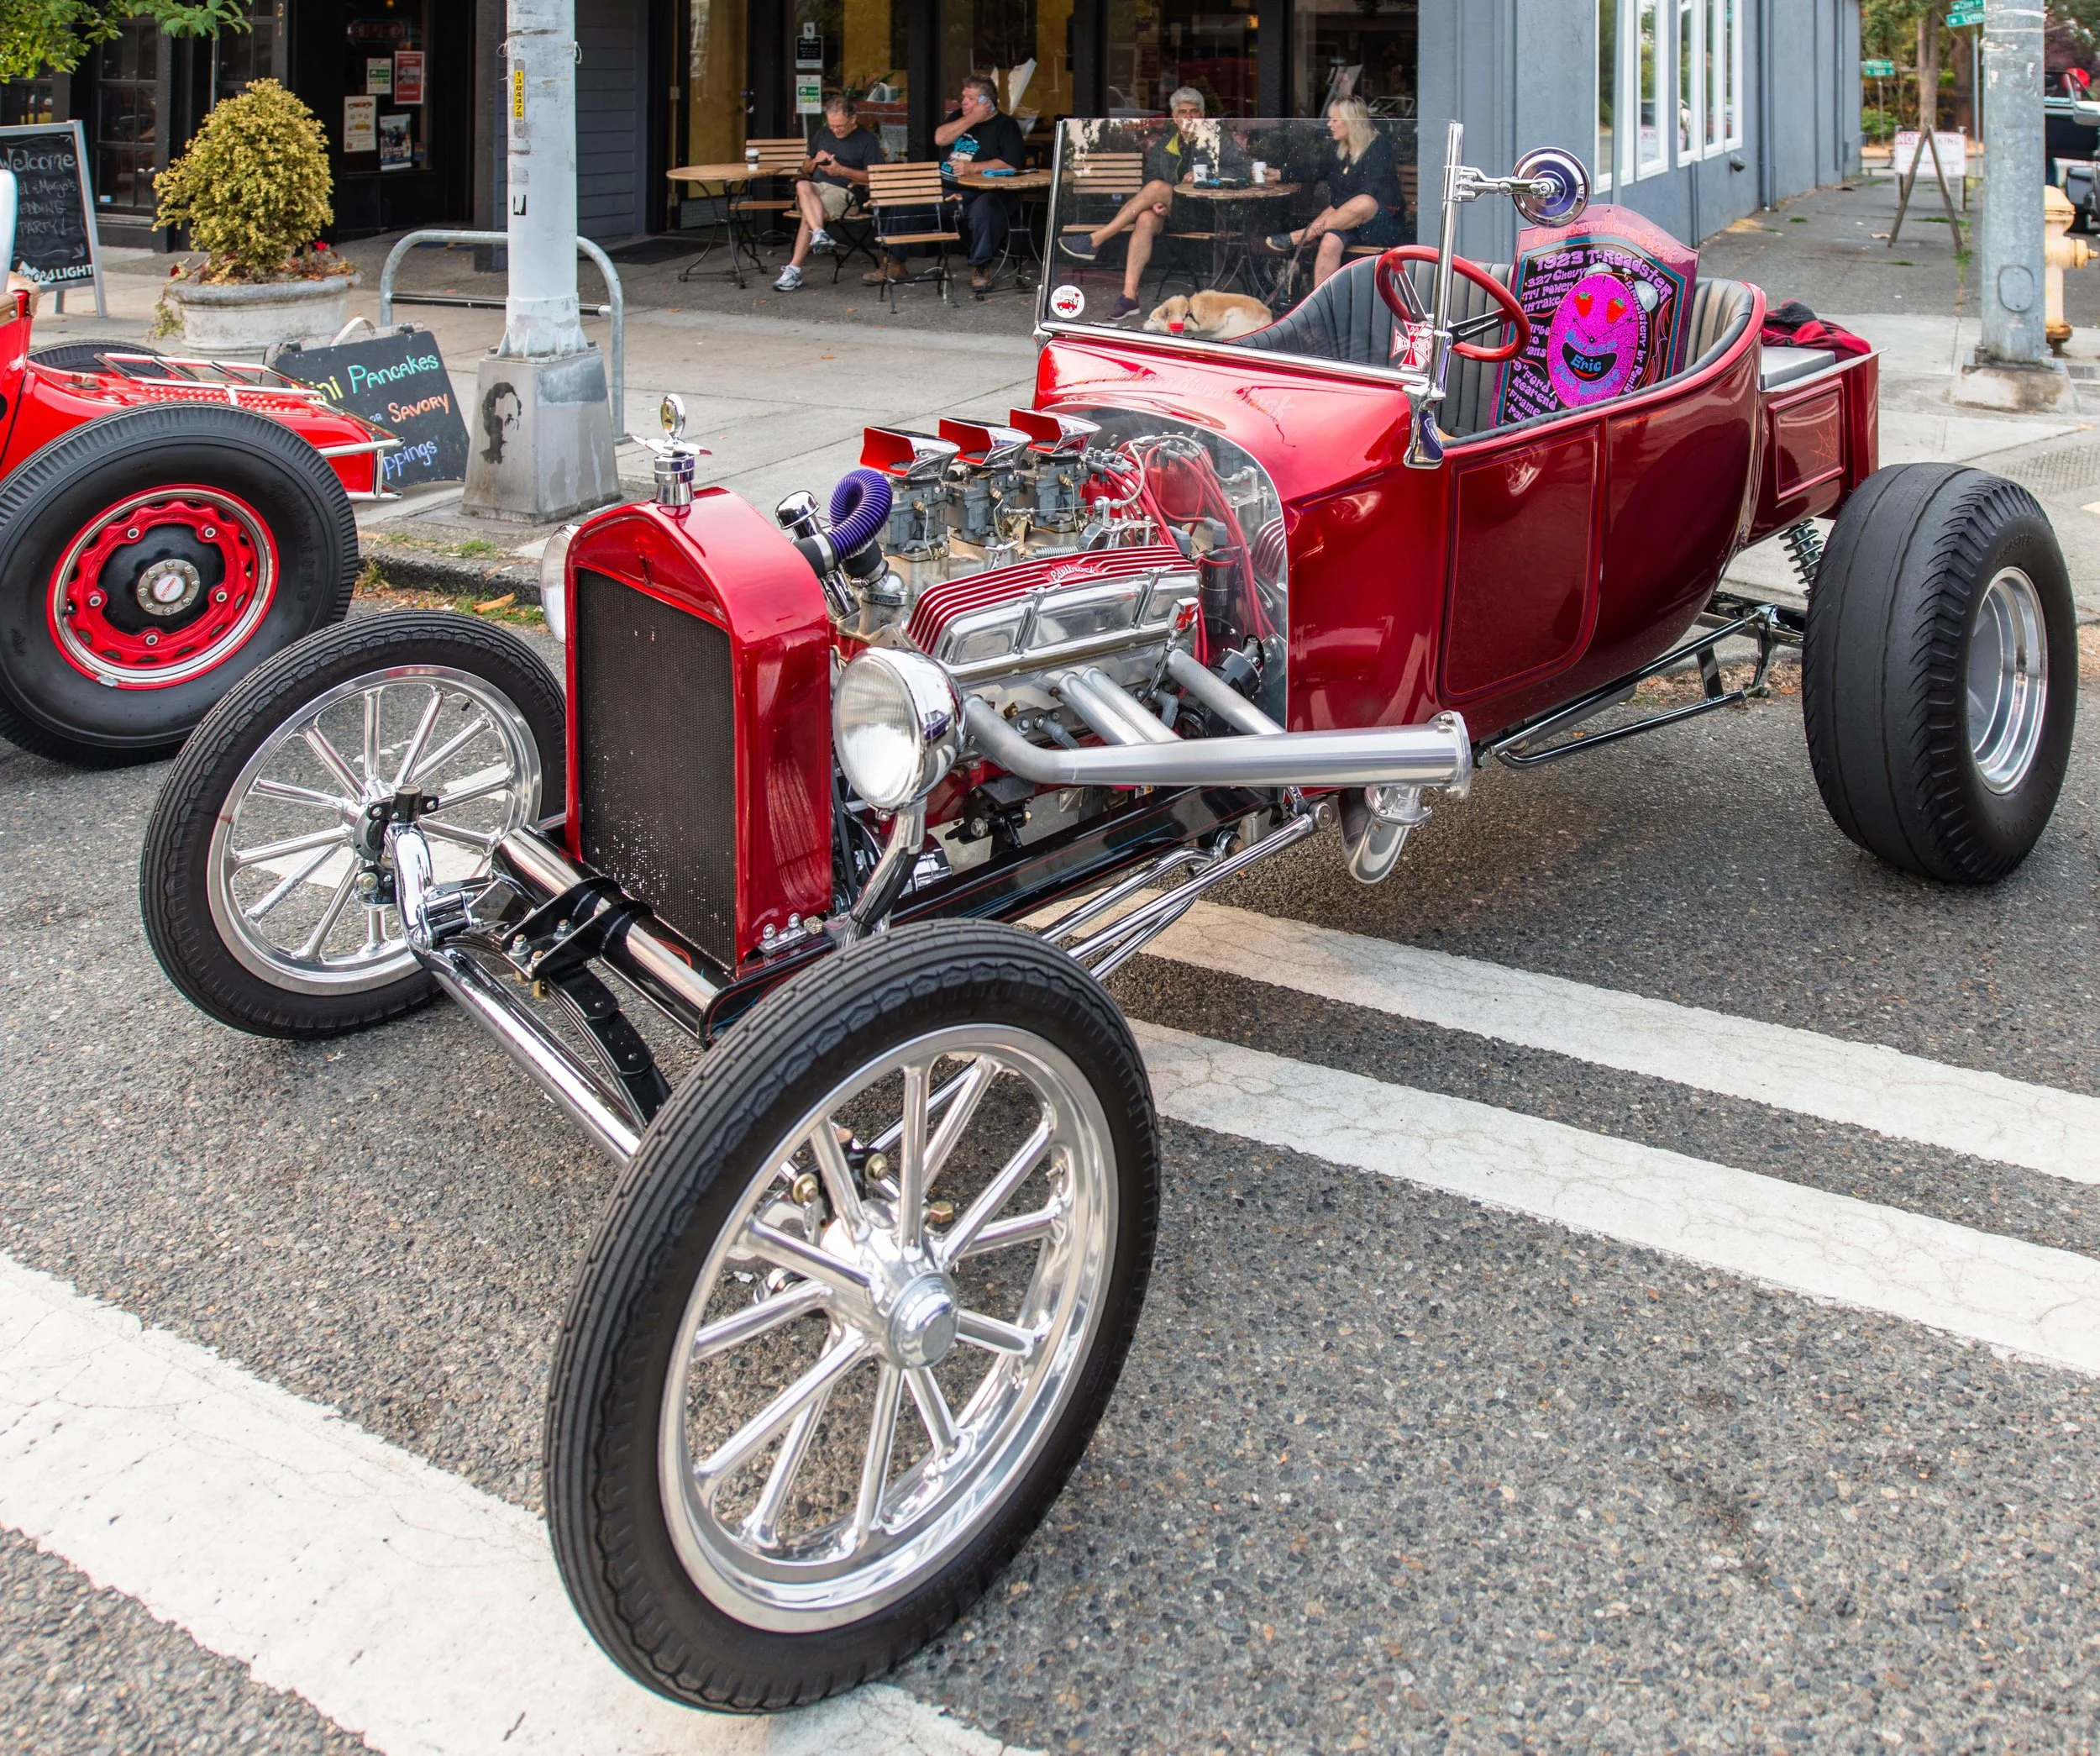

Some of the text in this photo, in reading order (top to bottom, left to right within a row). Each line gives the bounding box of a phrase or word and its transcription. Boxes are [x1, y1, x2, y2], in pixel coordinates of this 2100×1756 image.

[0, 148, 76, 172] Welcome
[19, 201, 66, 215] EDDING
[1536, 250, 1584, 271] 1923
[56, 264, 93, 280] LIGHT
[1527, 267, 1588, 287] 327 Chevy
[1570, 354, 1602, 372] Eric
[347, 355, 439, 394] Pancakes
[382, 440, 438, 480] ppings
[1049, 564, 1096, 582] Edelbrock
